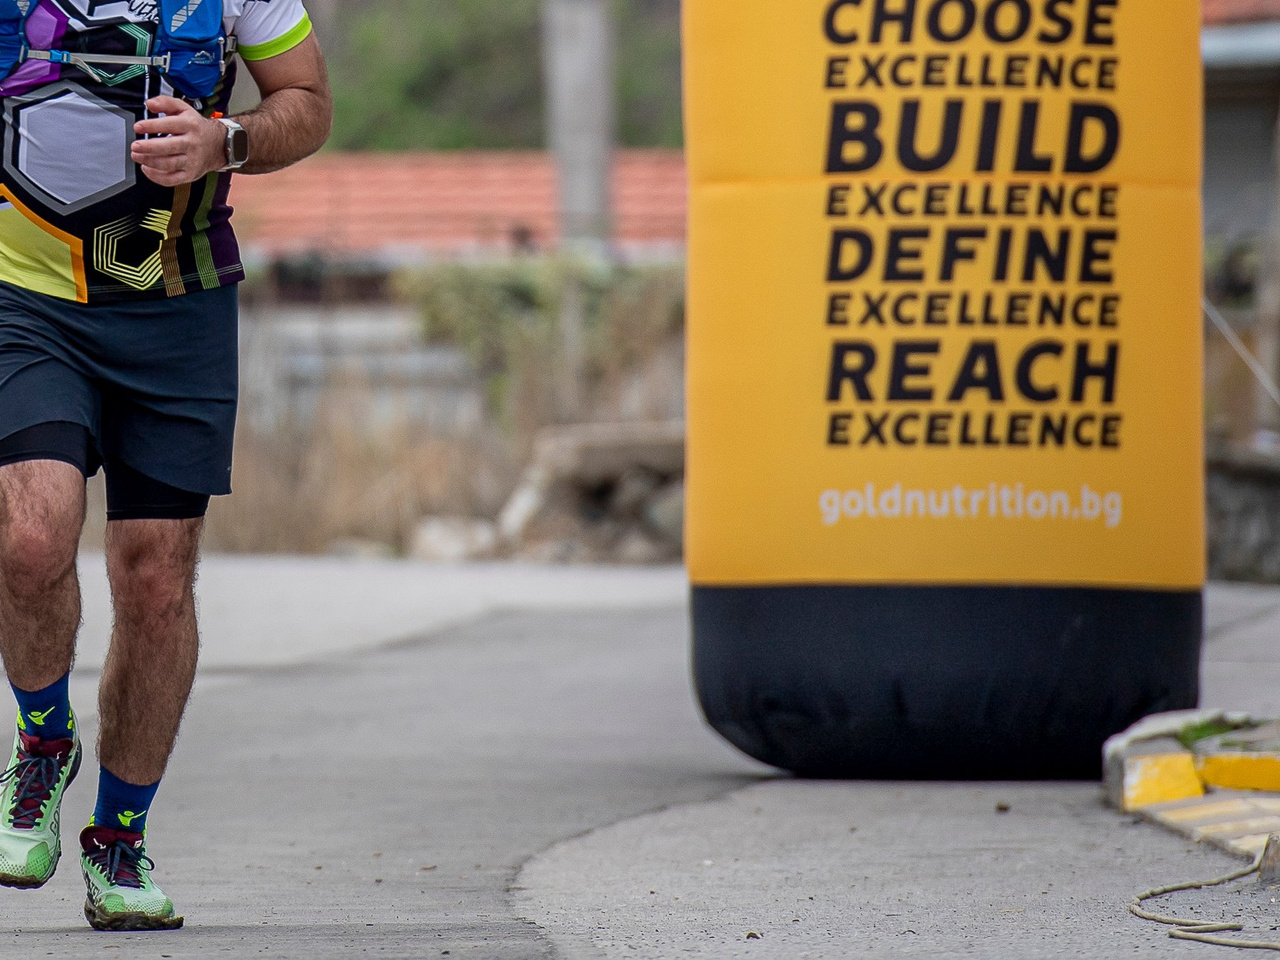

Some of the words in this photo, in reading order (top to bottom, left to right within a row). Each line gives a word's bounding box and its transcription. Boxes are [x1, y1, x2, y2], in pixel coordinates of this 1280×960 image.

[824, 54, 1119, 91] EXCELLENCE
[824, 98, 1121, 175] BUILD
[825, 183, 1120, 219] EXCELLENCE
[825, 226, 1118, 285] DEFINE
[826, 292, 1120, 329] EXCELLENCE
[825, 339, 1120, 405] REACH
[827, 412, 1123, 449] EXCELLENCE
[818, 482, 1123, 527] goldnutrition.bg
